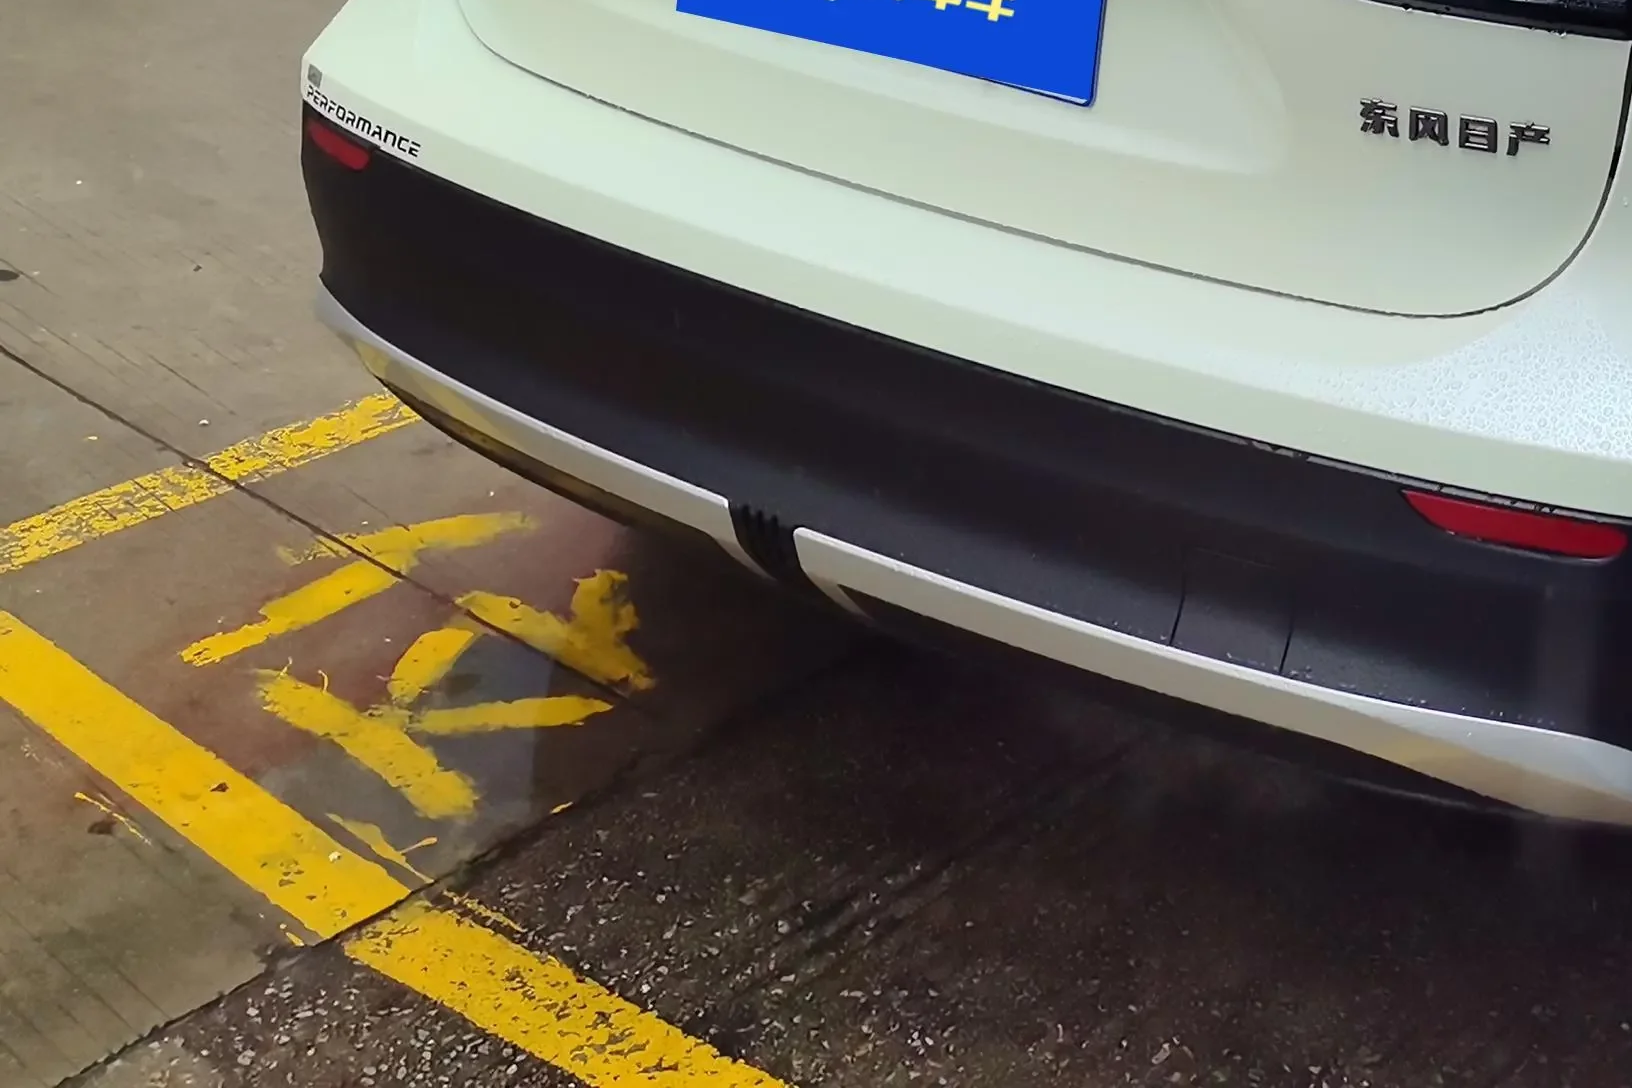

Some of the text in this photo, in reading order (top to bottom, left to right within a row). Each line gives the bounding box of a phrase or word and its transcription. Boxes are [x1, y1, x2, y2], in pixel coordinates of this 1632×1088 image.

[306, 84, 422, 158] PERFORMANCE
[1359, 97, 1551, 156] 东风日产
